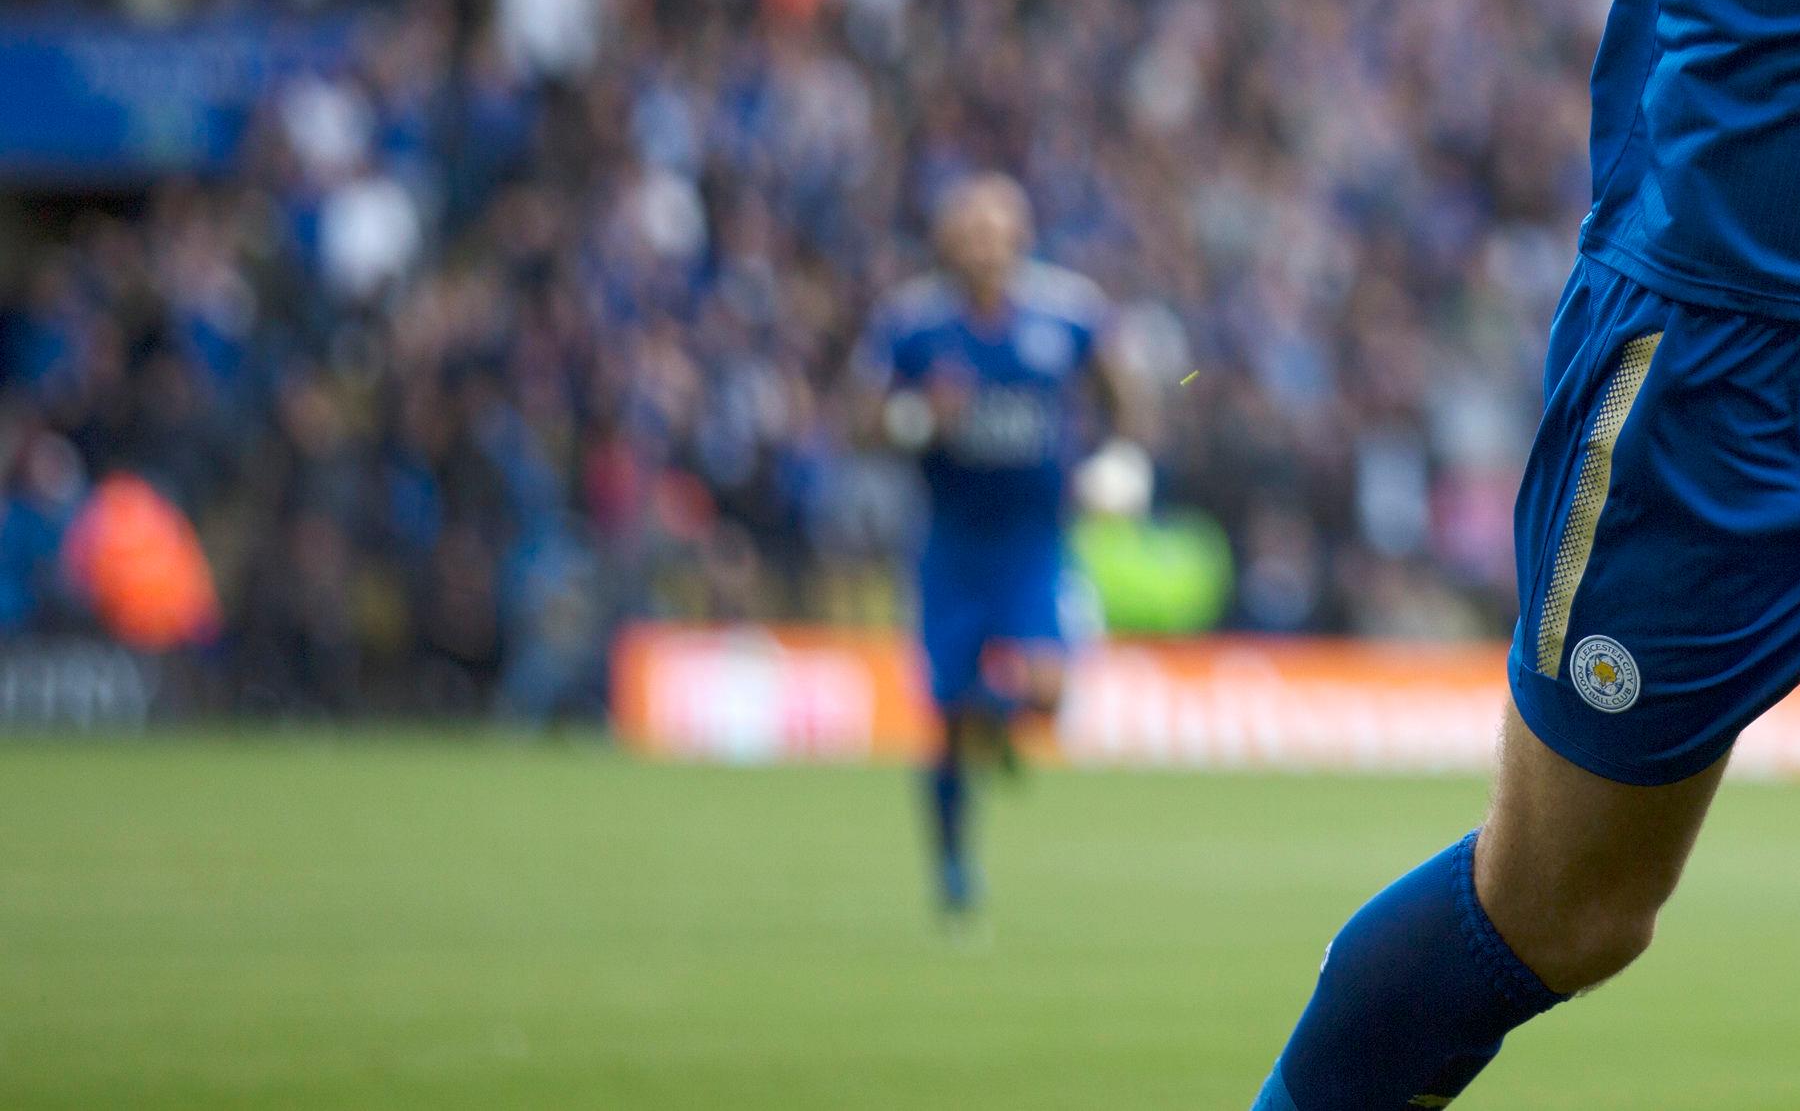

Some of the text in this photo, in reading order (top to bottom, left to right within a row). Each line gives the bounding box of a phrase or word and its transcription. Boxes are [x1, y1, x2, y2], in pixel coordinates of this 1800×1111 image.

[1580, 643, 1634, 685] LEICESTER CITY
[1577, 665, 1632, 706] FOOTBALL CLUB
